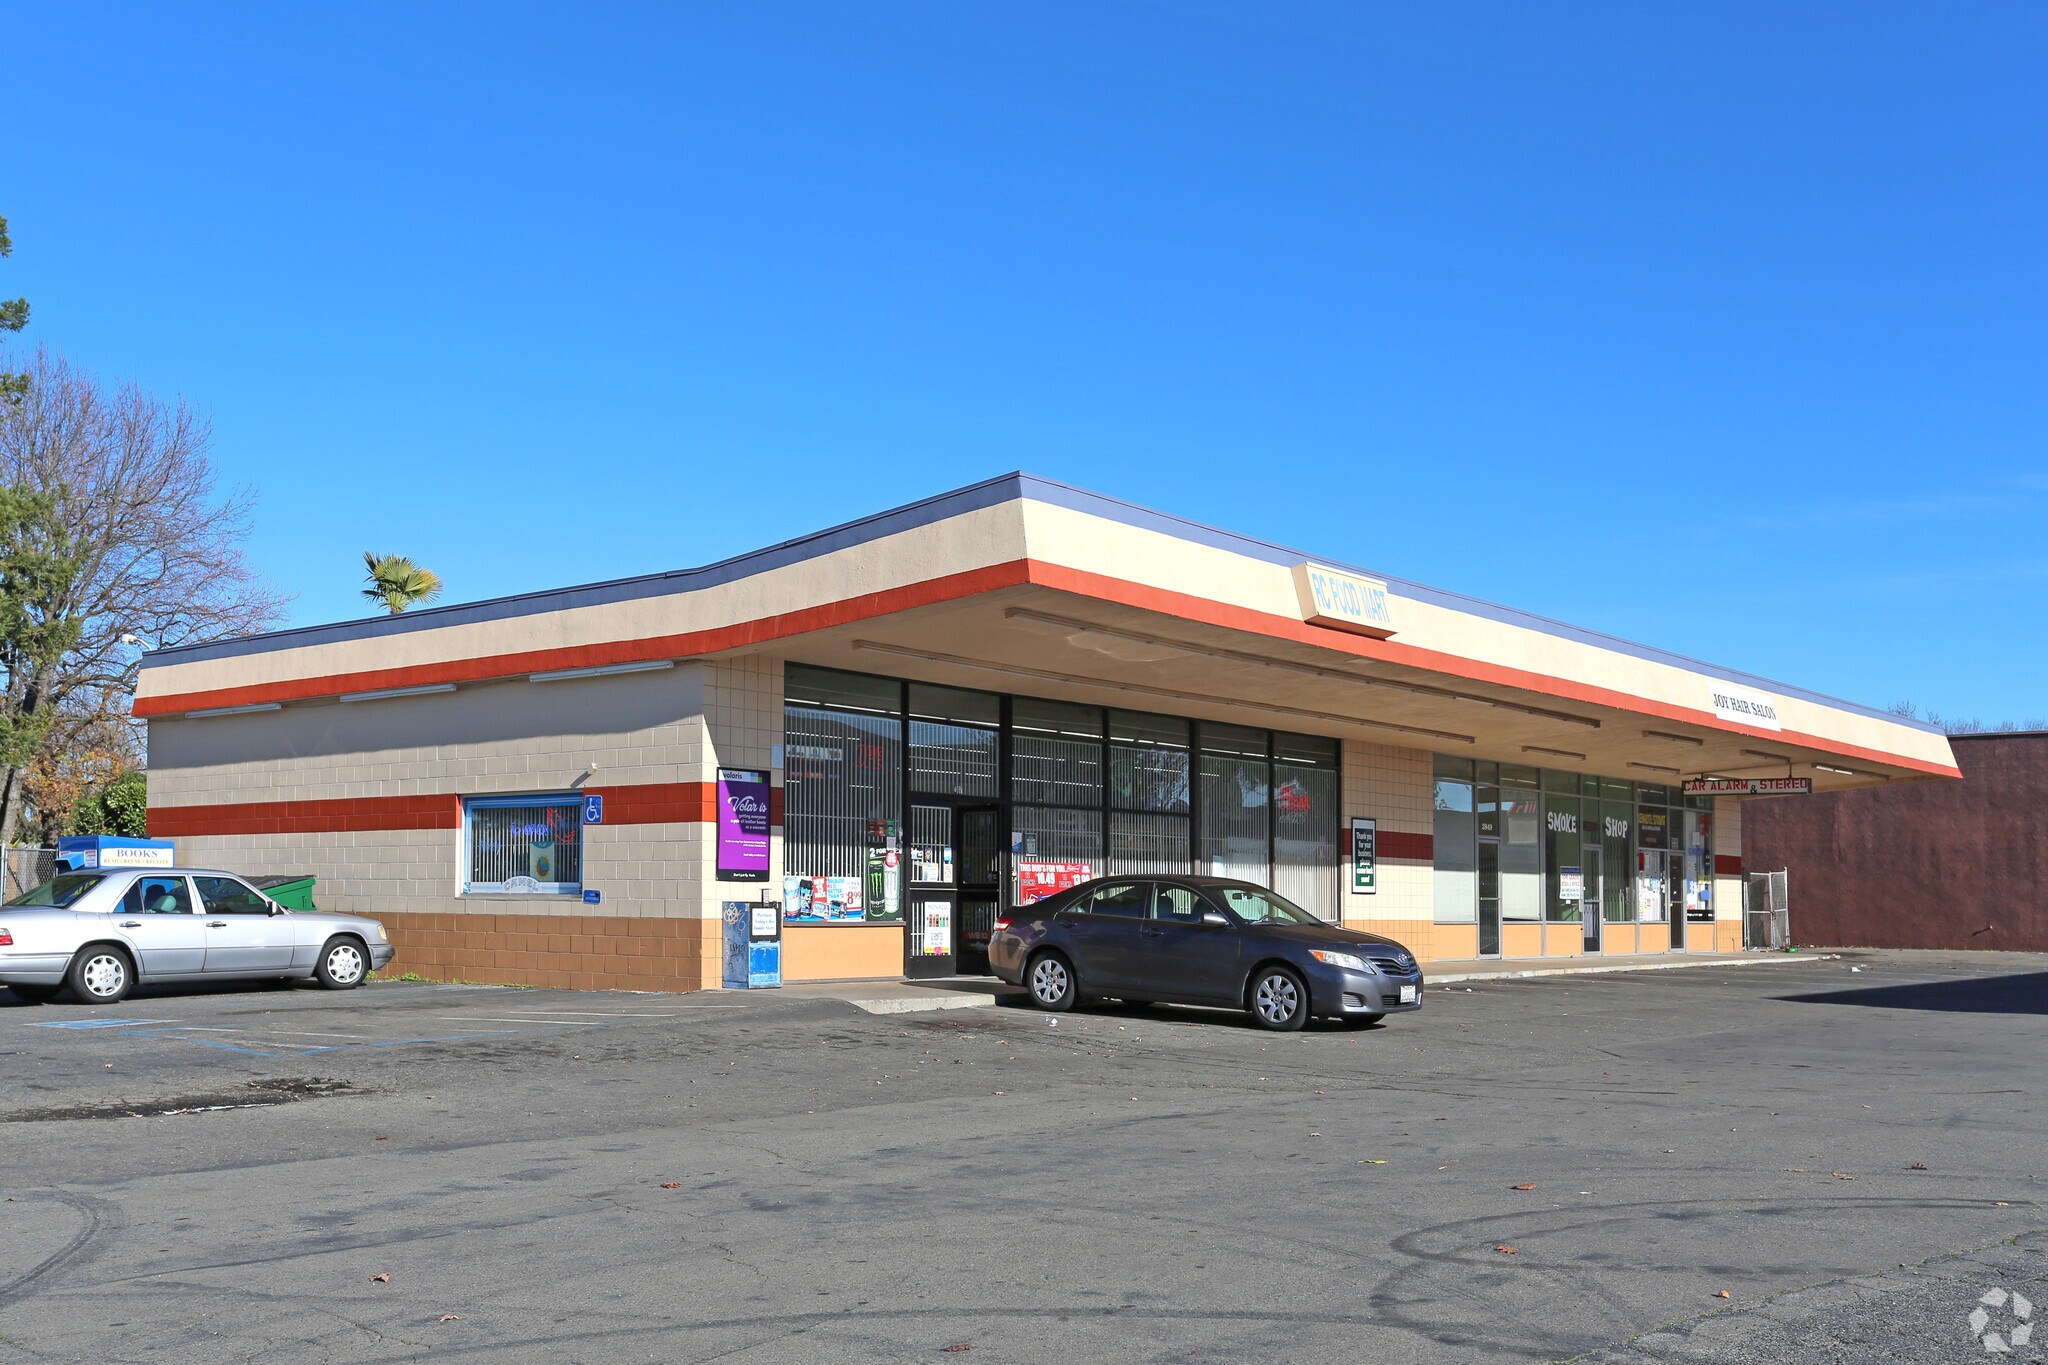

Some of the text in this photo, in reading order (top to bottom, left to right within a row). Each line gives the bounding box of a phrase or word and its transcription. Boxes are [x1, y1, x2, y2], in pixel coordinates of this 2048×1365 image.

[1311, 573, 1390, 623] RC FOOD MART
[1713, 693, 1777, 720] JOY HAIR SALON
[723, 771, 742, 779] volaris
[1683, 778, 1808, 794] CAR ALARM & STEREO
[727, 795, 767, 812] Volar is
[1547, 811, 1628, 839] SMOKE SHOP
[117, 849, 158, 858] BOOKS
[1020, 864, 1031, 872] THIS
[1046, 864, 1056, 872] FOR
[504, 878, 538, 892] CAMEL
